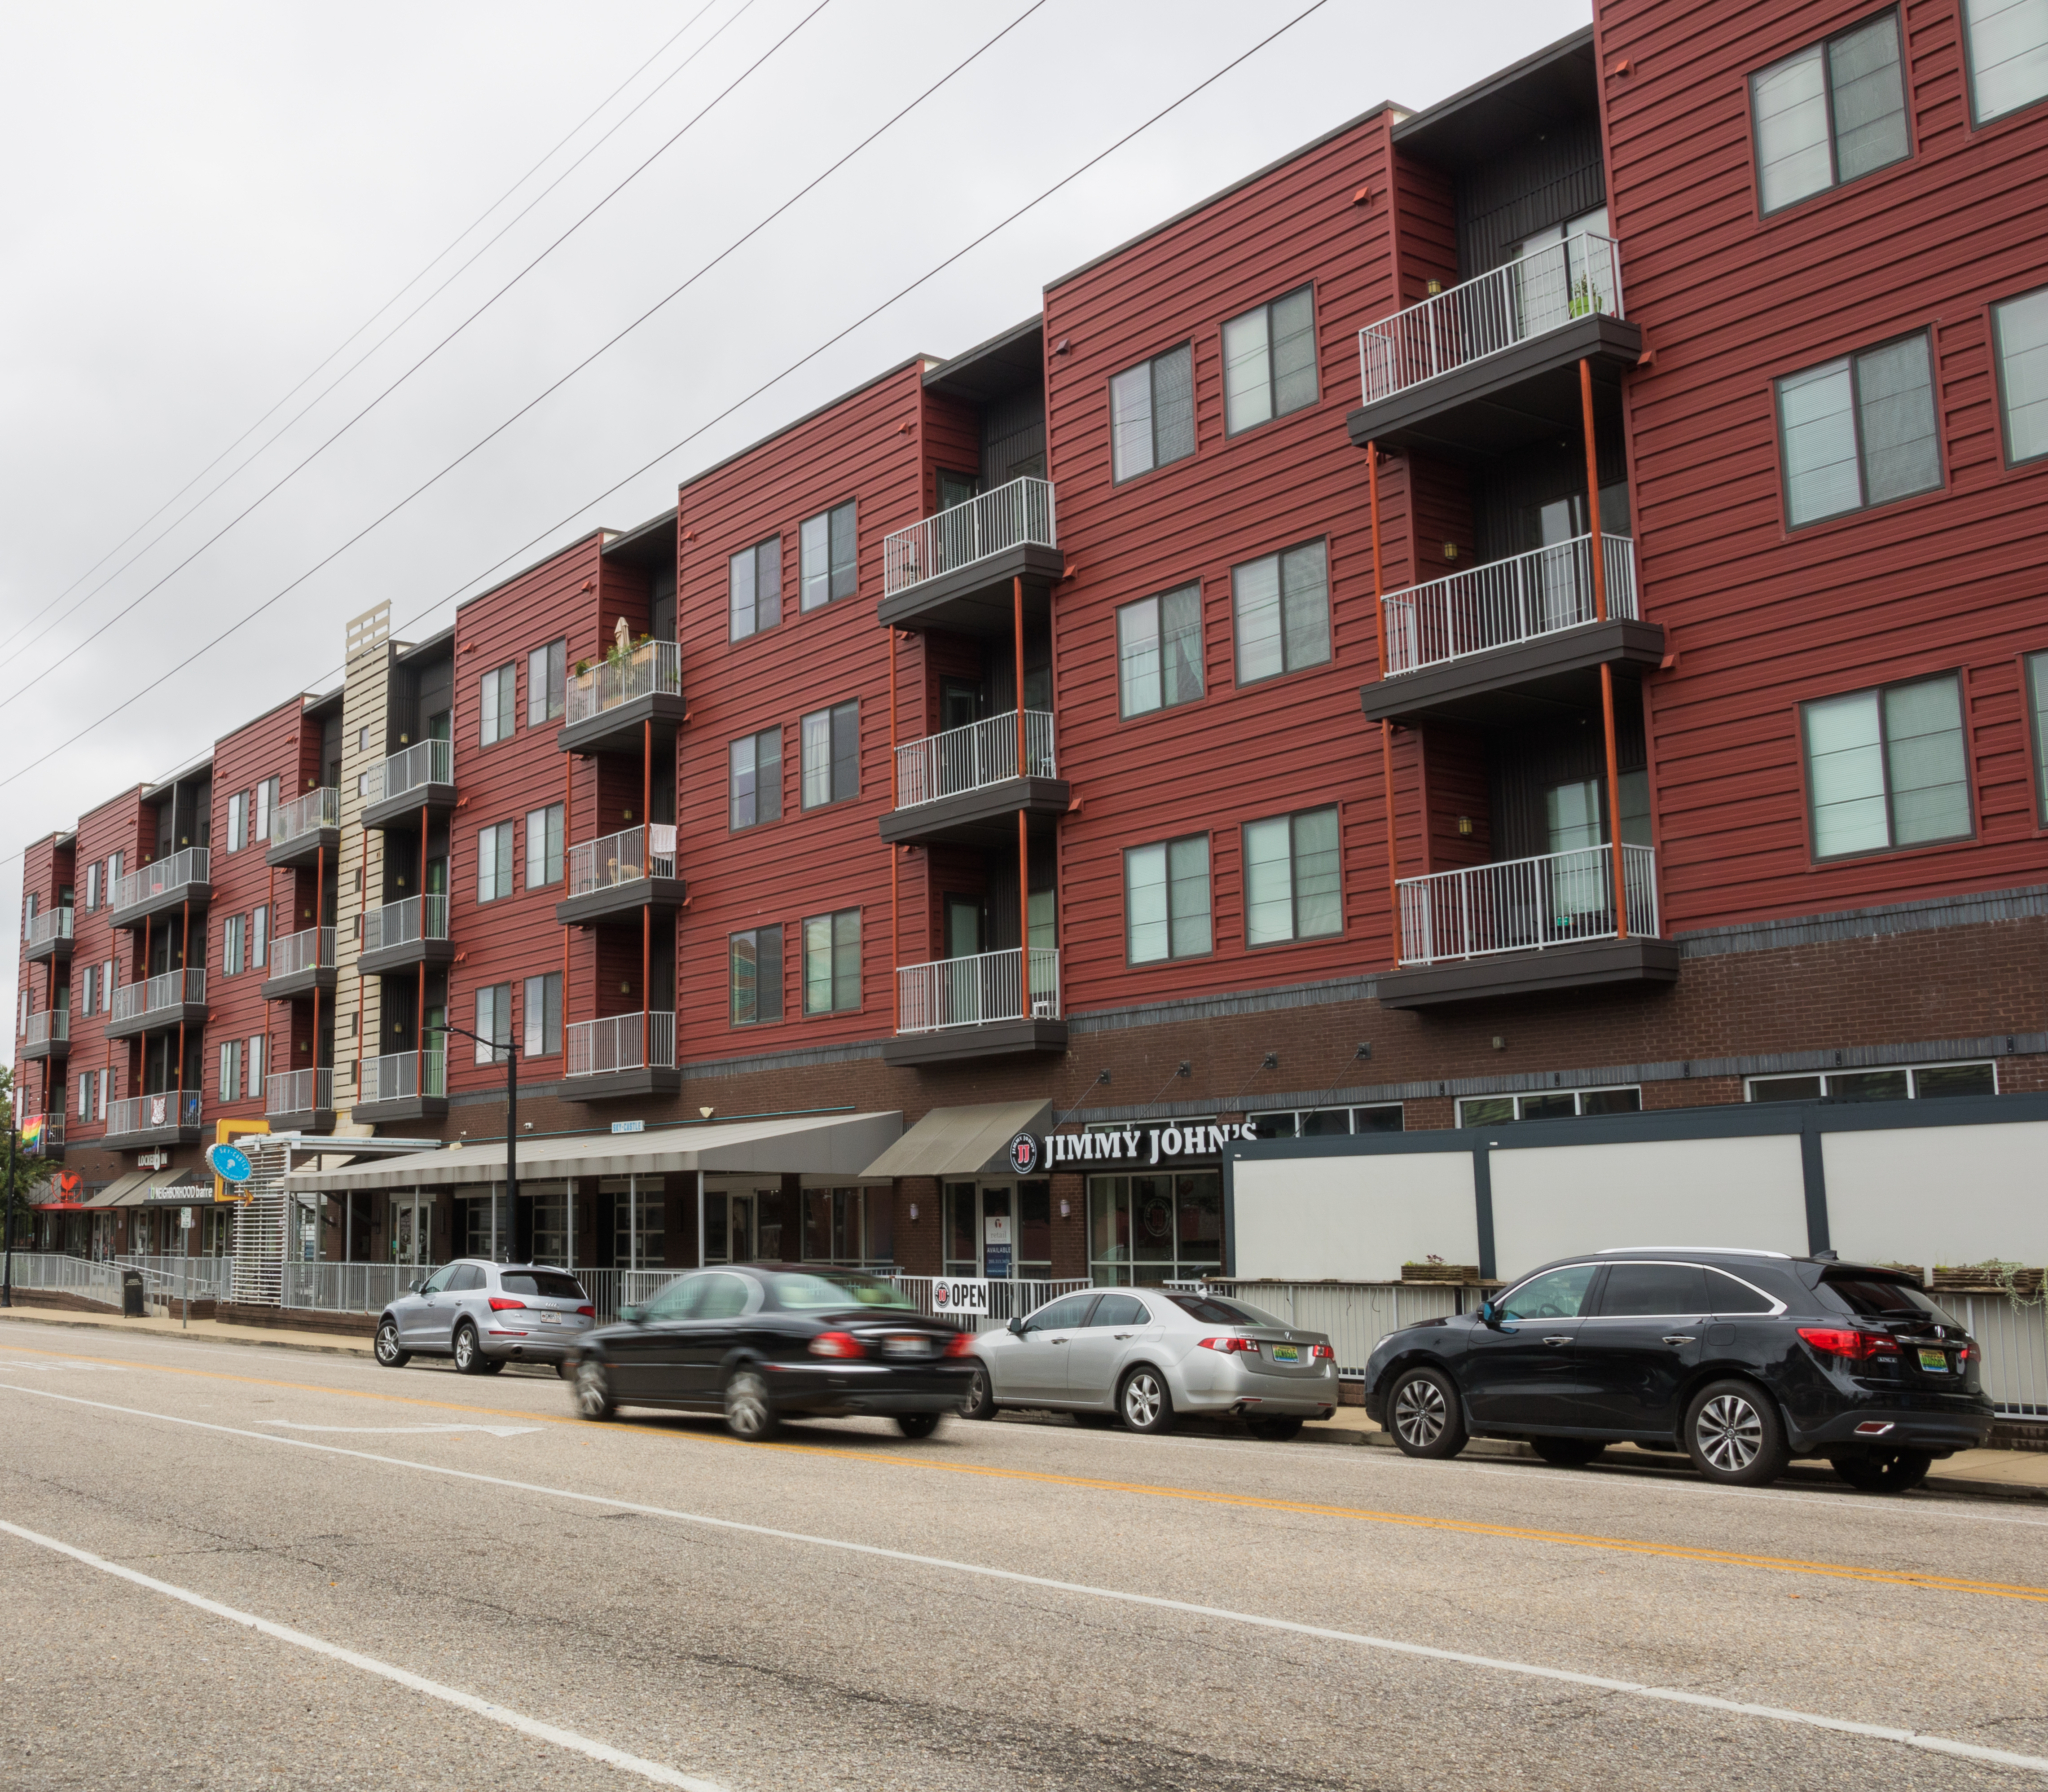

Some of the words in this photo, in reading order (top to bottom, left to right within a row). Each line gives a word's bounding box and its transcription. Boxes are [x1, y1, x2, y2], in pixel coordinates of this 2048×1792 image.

[1045, 1131, 1141, 1168] JIMMY
[1150, 1122, 1257, 1164] JOHN'S
[160, 1152, 168, 1165] IN
[155, 1185, 195, 1199] NEIGHBORHOOD
[195, 1184, 213, 1198] barre
[987, 1246, 1011, 1254] AVAILABLE
[952, 1283, 987, 1308] OPEN
